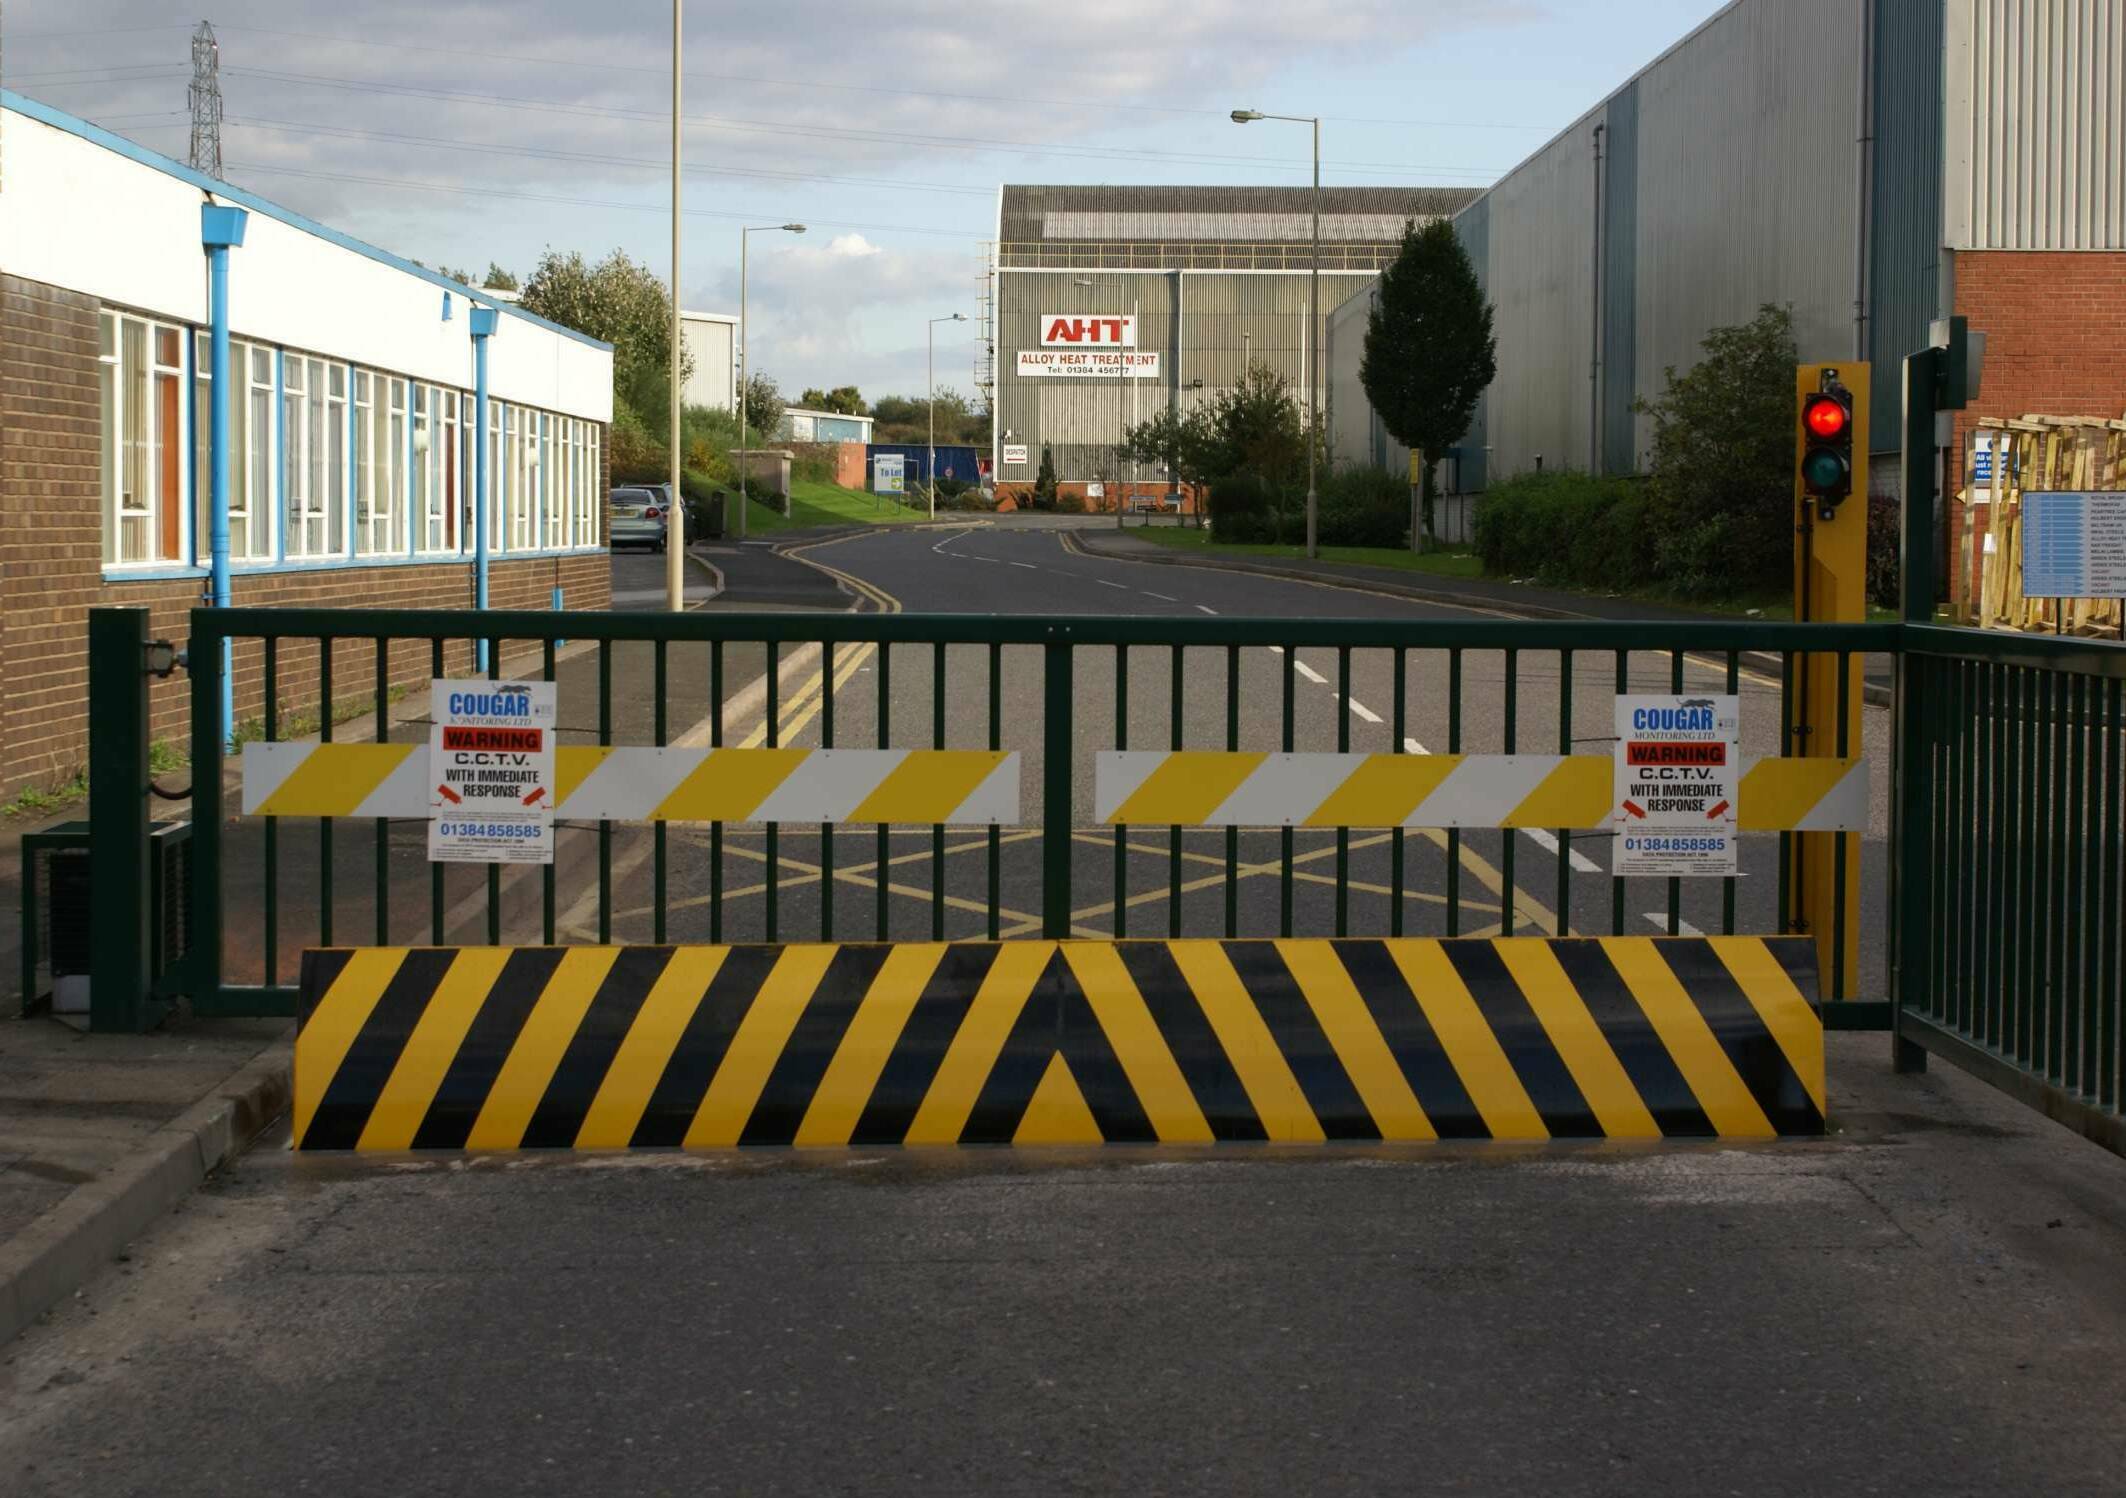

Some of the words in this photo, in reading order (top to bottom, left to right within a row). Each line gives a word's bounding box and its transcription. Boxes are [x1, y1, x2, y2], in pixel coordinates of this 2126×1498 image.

[1046, 319, 1129, 342] AHT
[1021, 354, 1055, 364] ALLOY
[1060, 354, 1088, 364] HEAT
[1047, 366, 1062, 374] Tel:
[1067, 366, 1093, 374] 01384
[1098, 366, 1129, 374] 45677
[450, 693, 529, 716] COUGAR
[513, 718, 532, 726] LTD
[1634, 708, 1713, 730] COUGAR
[447, 732, 539, 749] WARNING
[1634, 732, 1696, 740] MONITORING
[1697, 732, 1716, 740] LTD
[455, 752, 530, 766] C.C.T.V.
[1631, 746, 1723, 763] WARNING
[446, 769, 475, 782] WITH
[478, 770, 539, 783] IMMEDIATE
[1639, 767, 1714, 780] C.C.T.V.
[463, 784, 521, 798] RESPONSE
[1630, 784, 1659, 797] WITH
[1662, 784, 1723, 797] IMMEDIATE
[1648, 799, 1705, 812] RESPONSE
